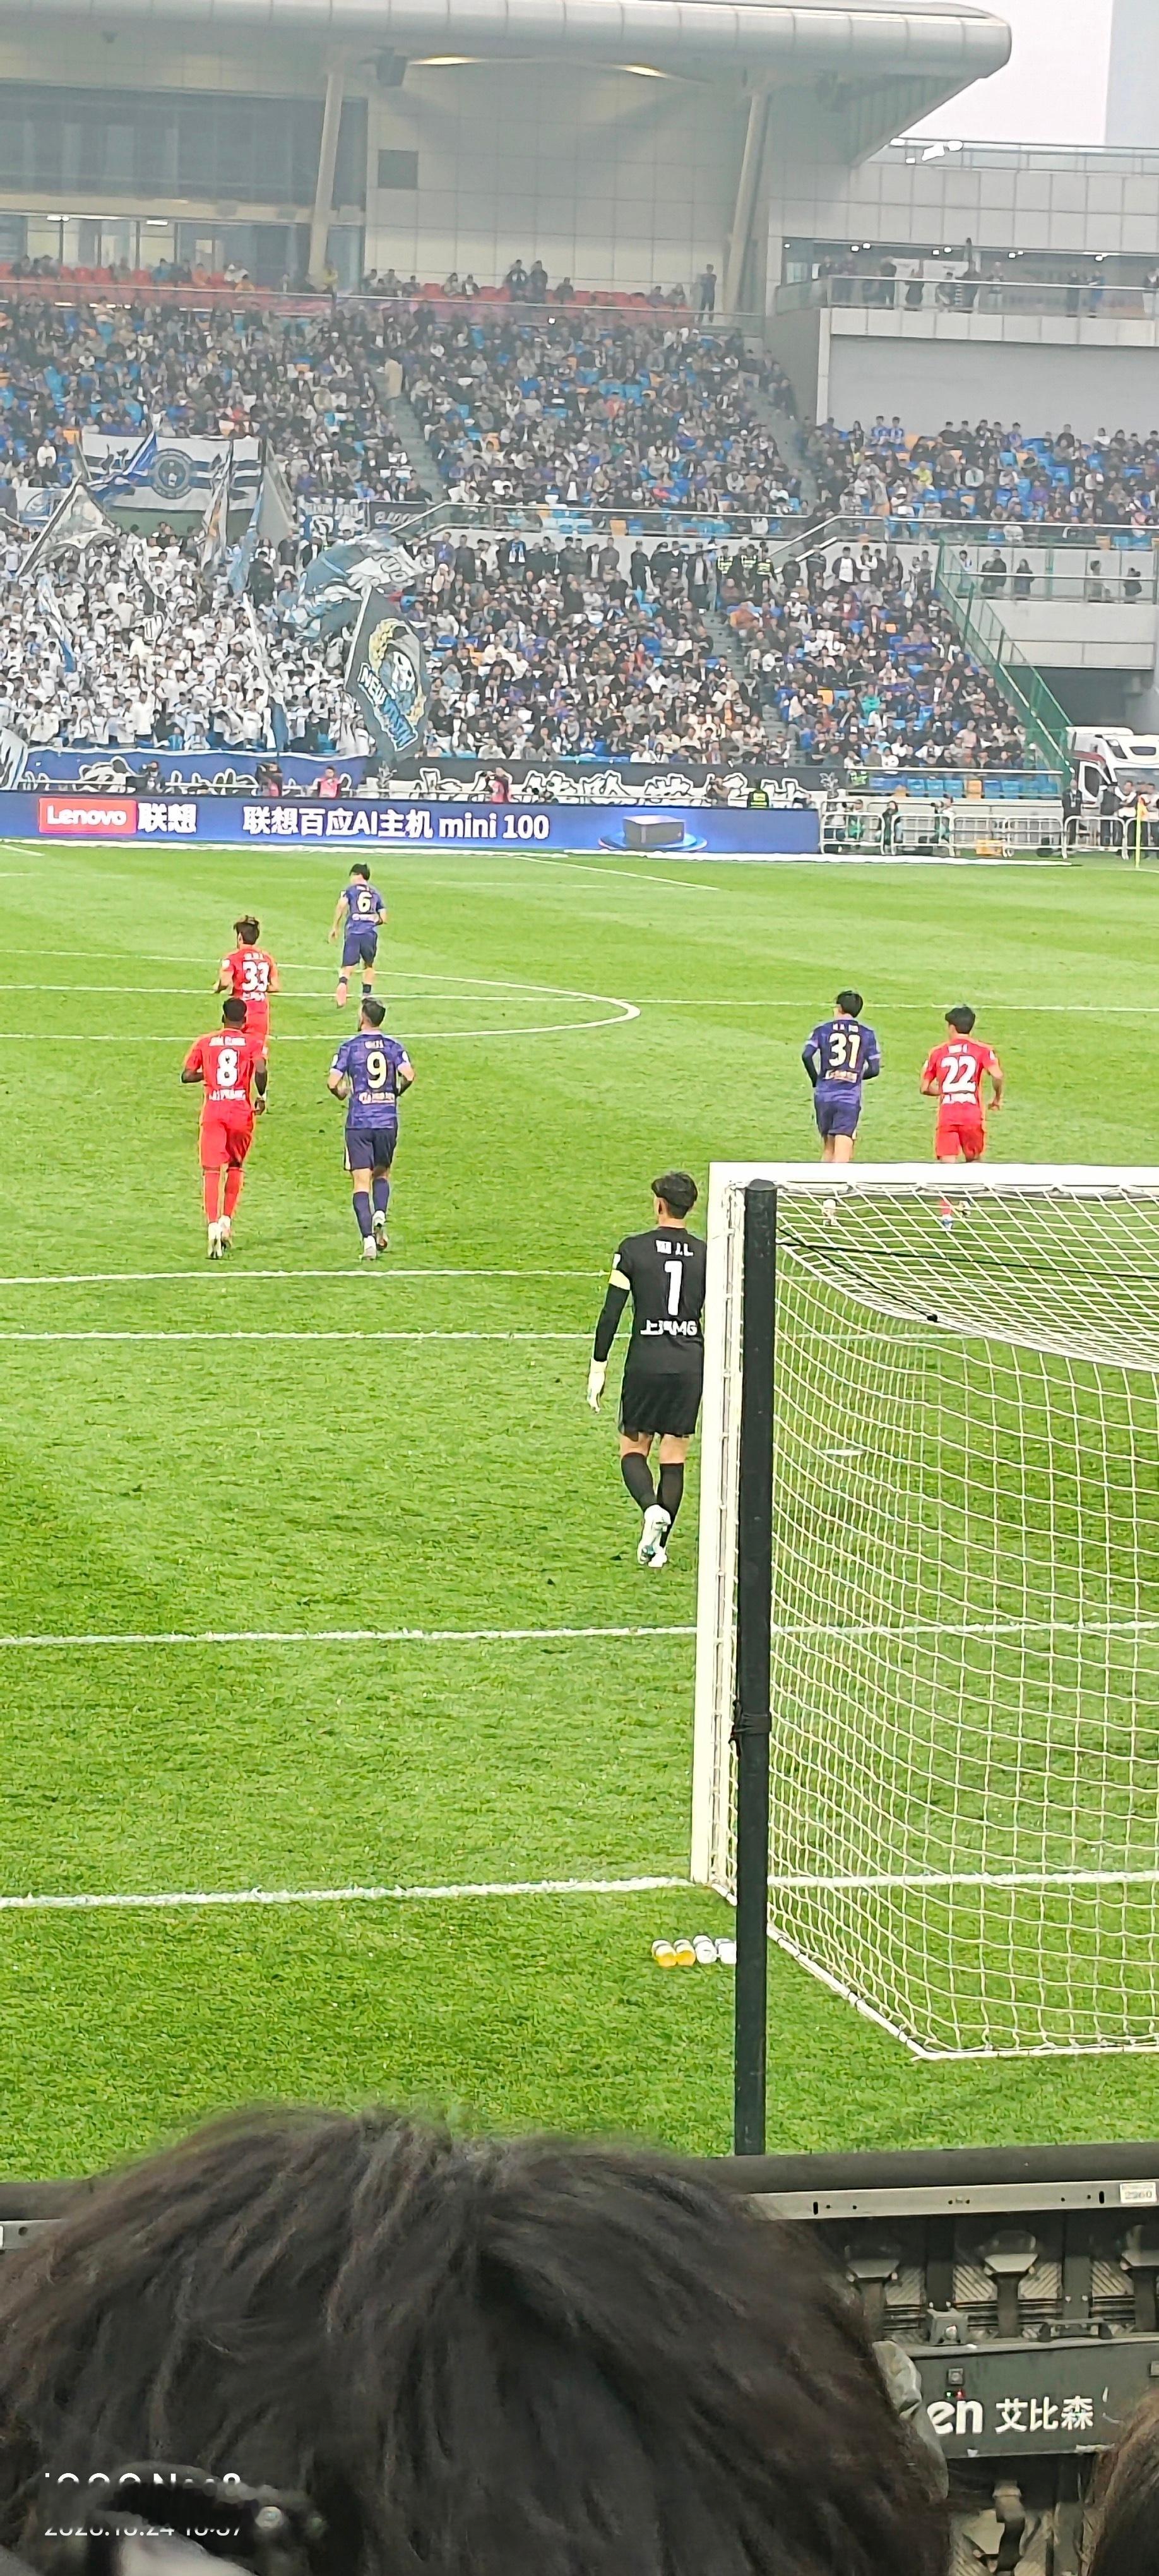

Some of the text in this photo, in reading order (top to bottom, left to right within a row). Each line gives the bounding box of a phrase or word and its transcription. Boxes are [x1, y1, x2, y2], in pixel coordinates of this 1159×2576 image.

[47, 802, 197, 833] Lenovo 联想
[242, 806, 550, 839] 联想百应AI主机 mini 100
[357, 891, 372, 913] 6
[242, 961, 270, 992] 33
[216, 1048, 238, 1087] 8
[829, 1032, 860, 1069] 31
[367, 1051, 386, 1088] 9
[941, 1056, 977, 1094] 22
[664, 1260, 682, 1315] 1
[995, 2395, 1093, 2434] 艾比森
